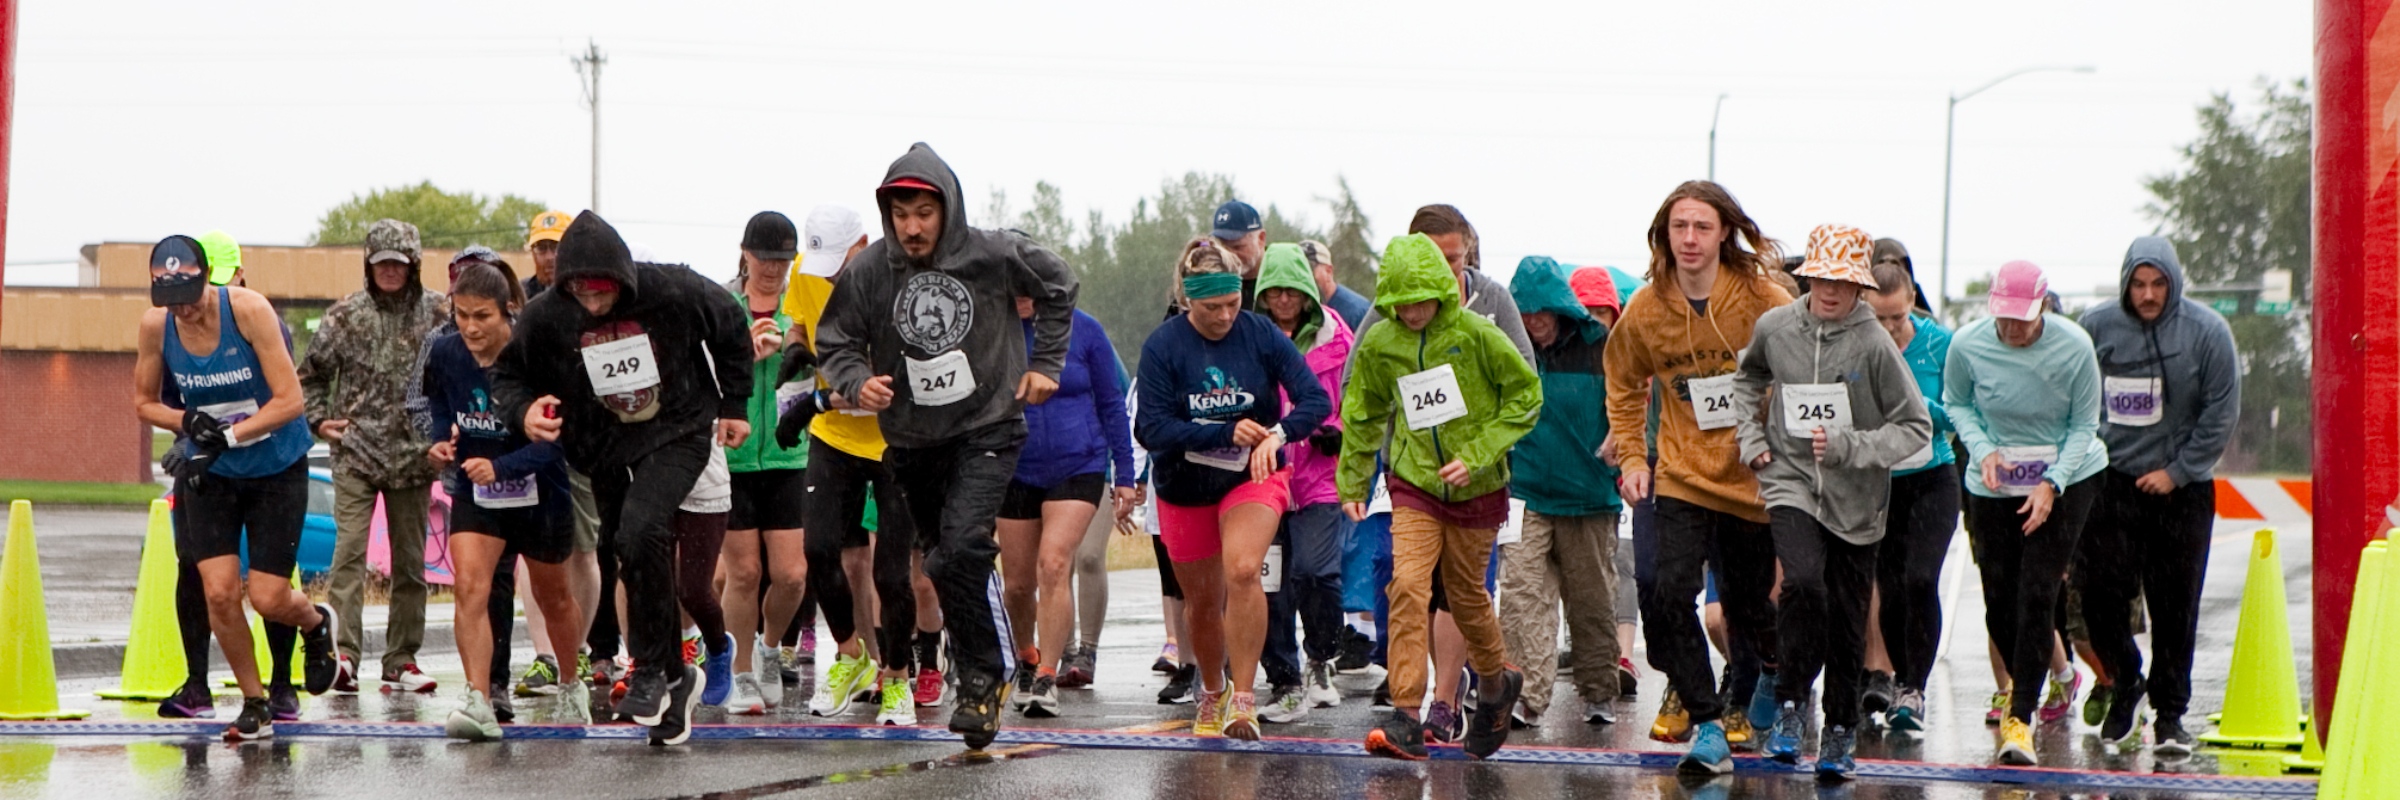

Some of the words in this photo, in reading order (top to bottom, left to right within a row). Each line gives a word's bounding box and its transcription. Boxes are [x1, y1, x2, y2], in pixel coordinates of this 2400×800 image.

[602, 356, 640, 379] 249
[920, 369, 957, 392] 247
[1188, 393, 1237, 410] KENAI
[1412, 387, 1447, 411] 246
[1704, 393, 1734, 412] 24
[2115, 396, 2154, 411] 1058
[456, 411, 496, 431] KENAI
[1798, 404, 1836, 420] 245
